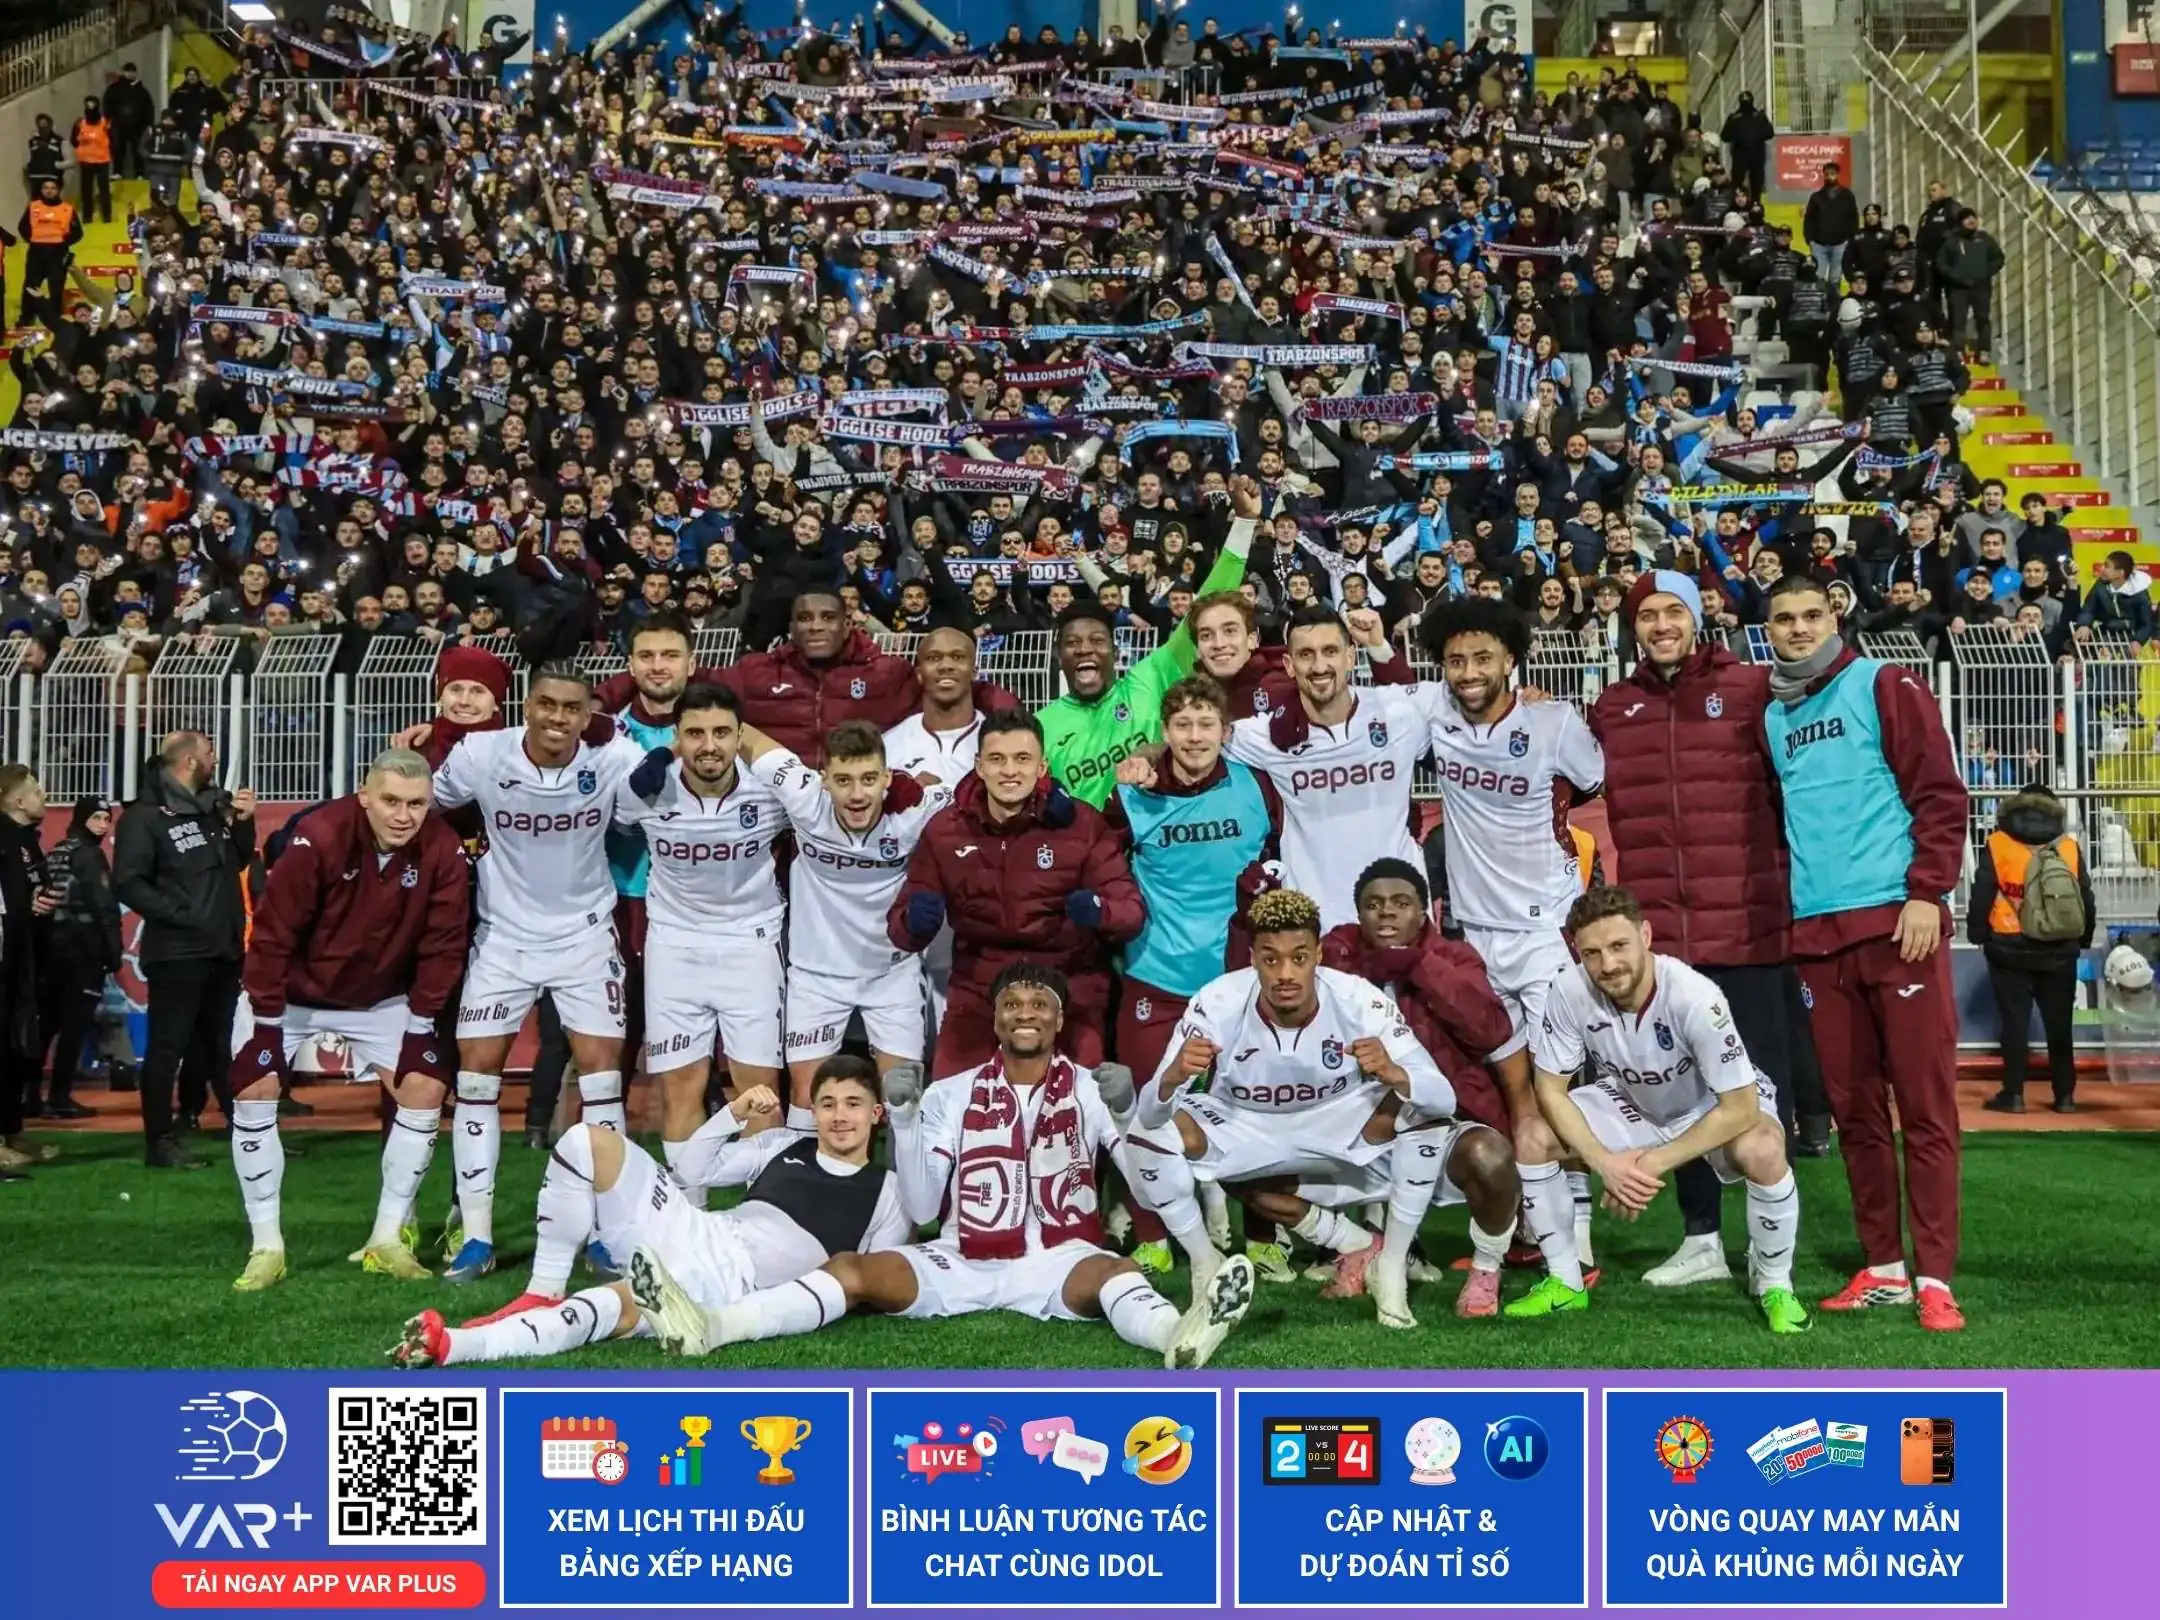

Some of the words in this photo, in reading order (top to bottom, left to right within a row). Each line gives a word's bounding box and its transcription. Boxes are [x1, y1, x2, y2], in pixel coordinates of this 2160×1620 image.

[483, 14, 518, 45] G
[1481, 3, 1518, 38] G
[422, 285, 498, 297] TRABON
[1267, 345, 1366, 363] TRABZONSPOR
[1004, 366, 1086, 383] TRABZONSPOR
[961, 462, 1047, 481] TRABZONSPOR
[1028, 563, 1079, 581] OOLS
[1065, 730, 1149, 788] papara
[1292, 758, 1396, 797] papara
[1435, 755, 1530, 798] papara
[495, 806, 602, 838] papara
[656, 838, 760, 866] papara
[493, 1001, 511, 1020] Go
[672, 1033, 690, 1051] Go
[820, 1024, 836, 1043] Go
